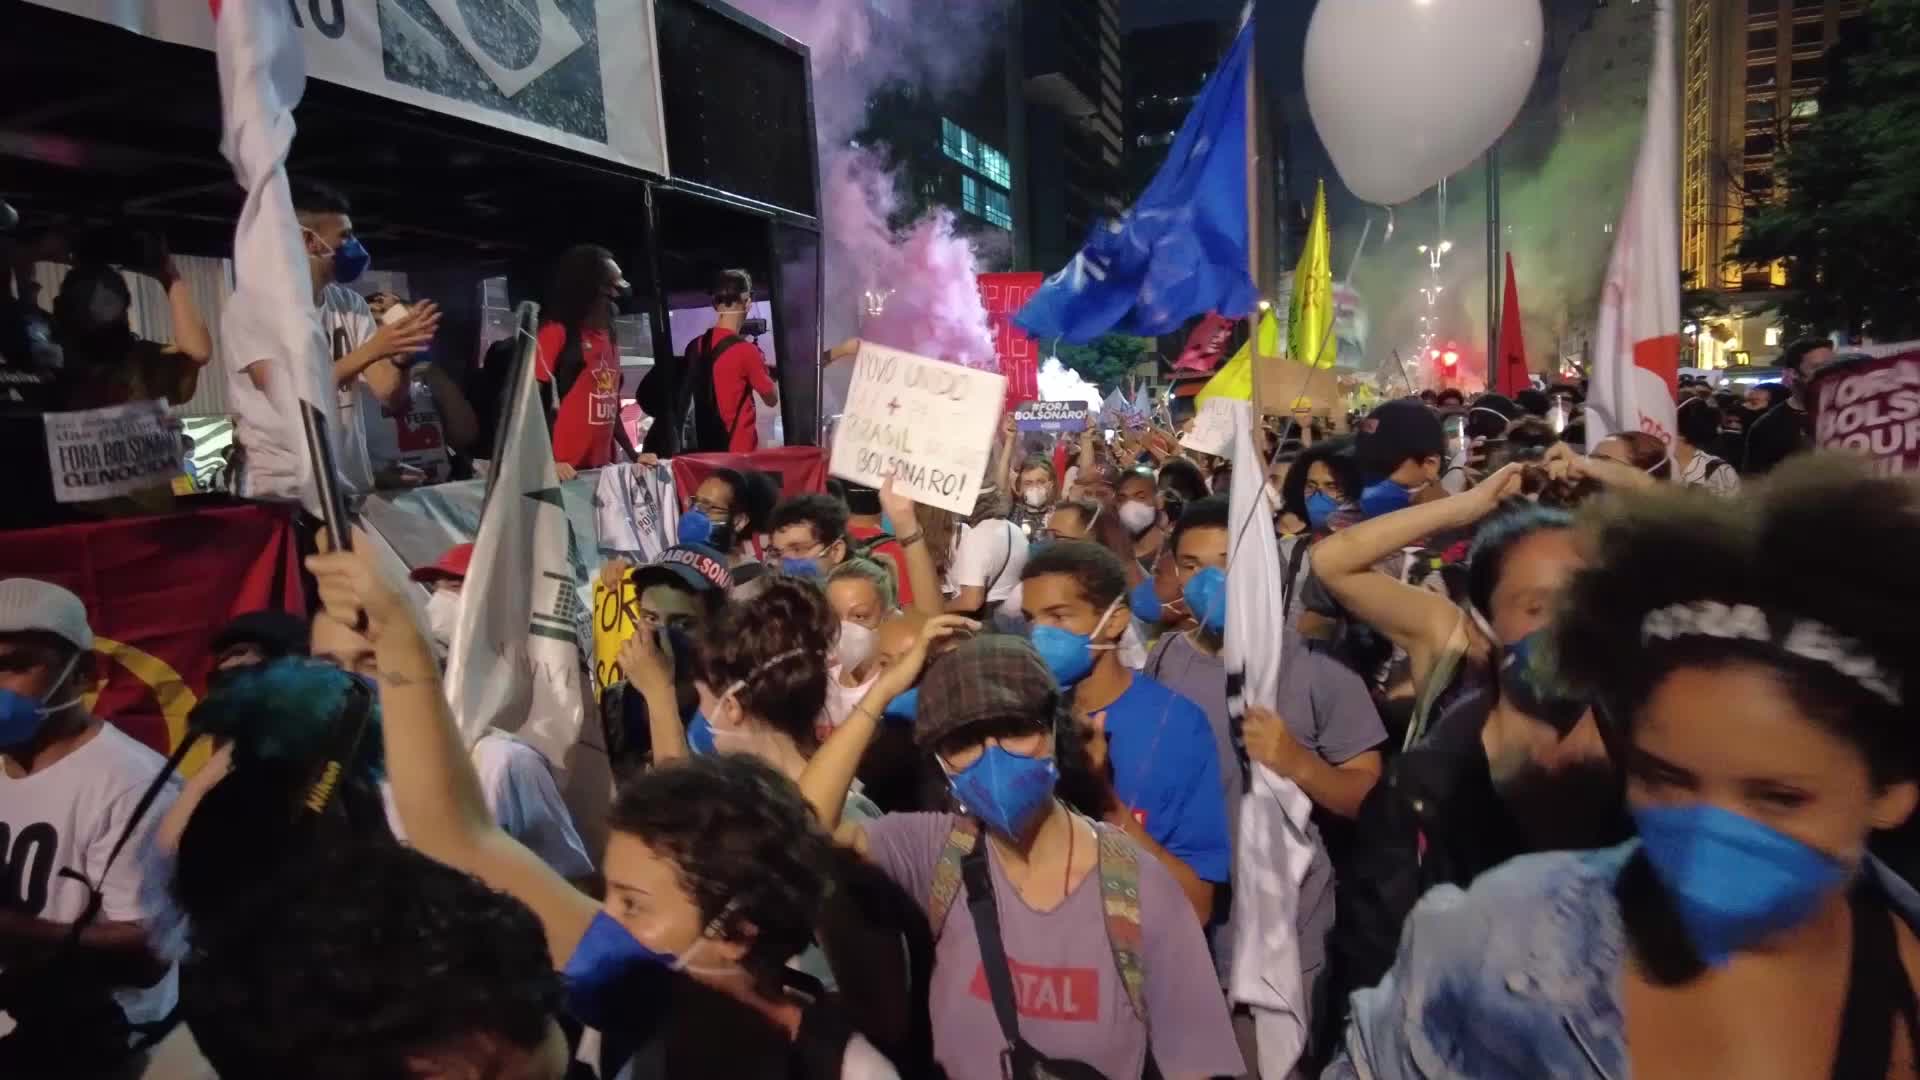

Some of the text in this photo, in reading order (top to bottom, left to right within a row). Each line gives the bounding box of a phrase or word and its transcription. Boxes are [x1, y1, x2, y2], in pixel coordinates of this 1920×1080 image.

[1031, 402, 1070, 411] #FORA
[1014, 409, 1088, 421] BOLSONARO!
[856, 447, 968, 501] BOLSONARO!
